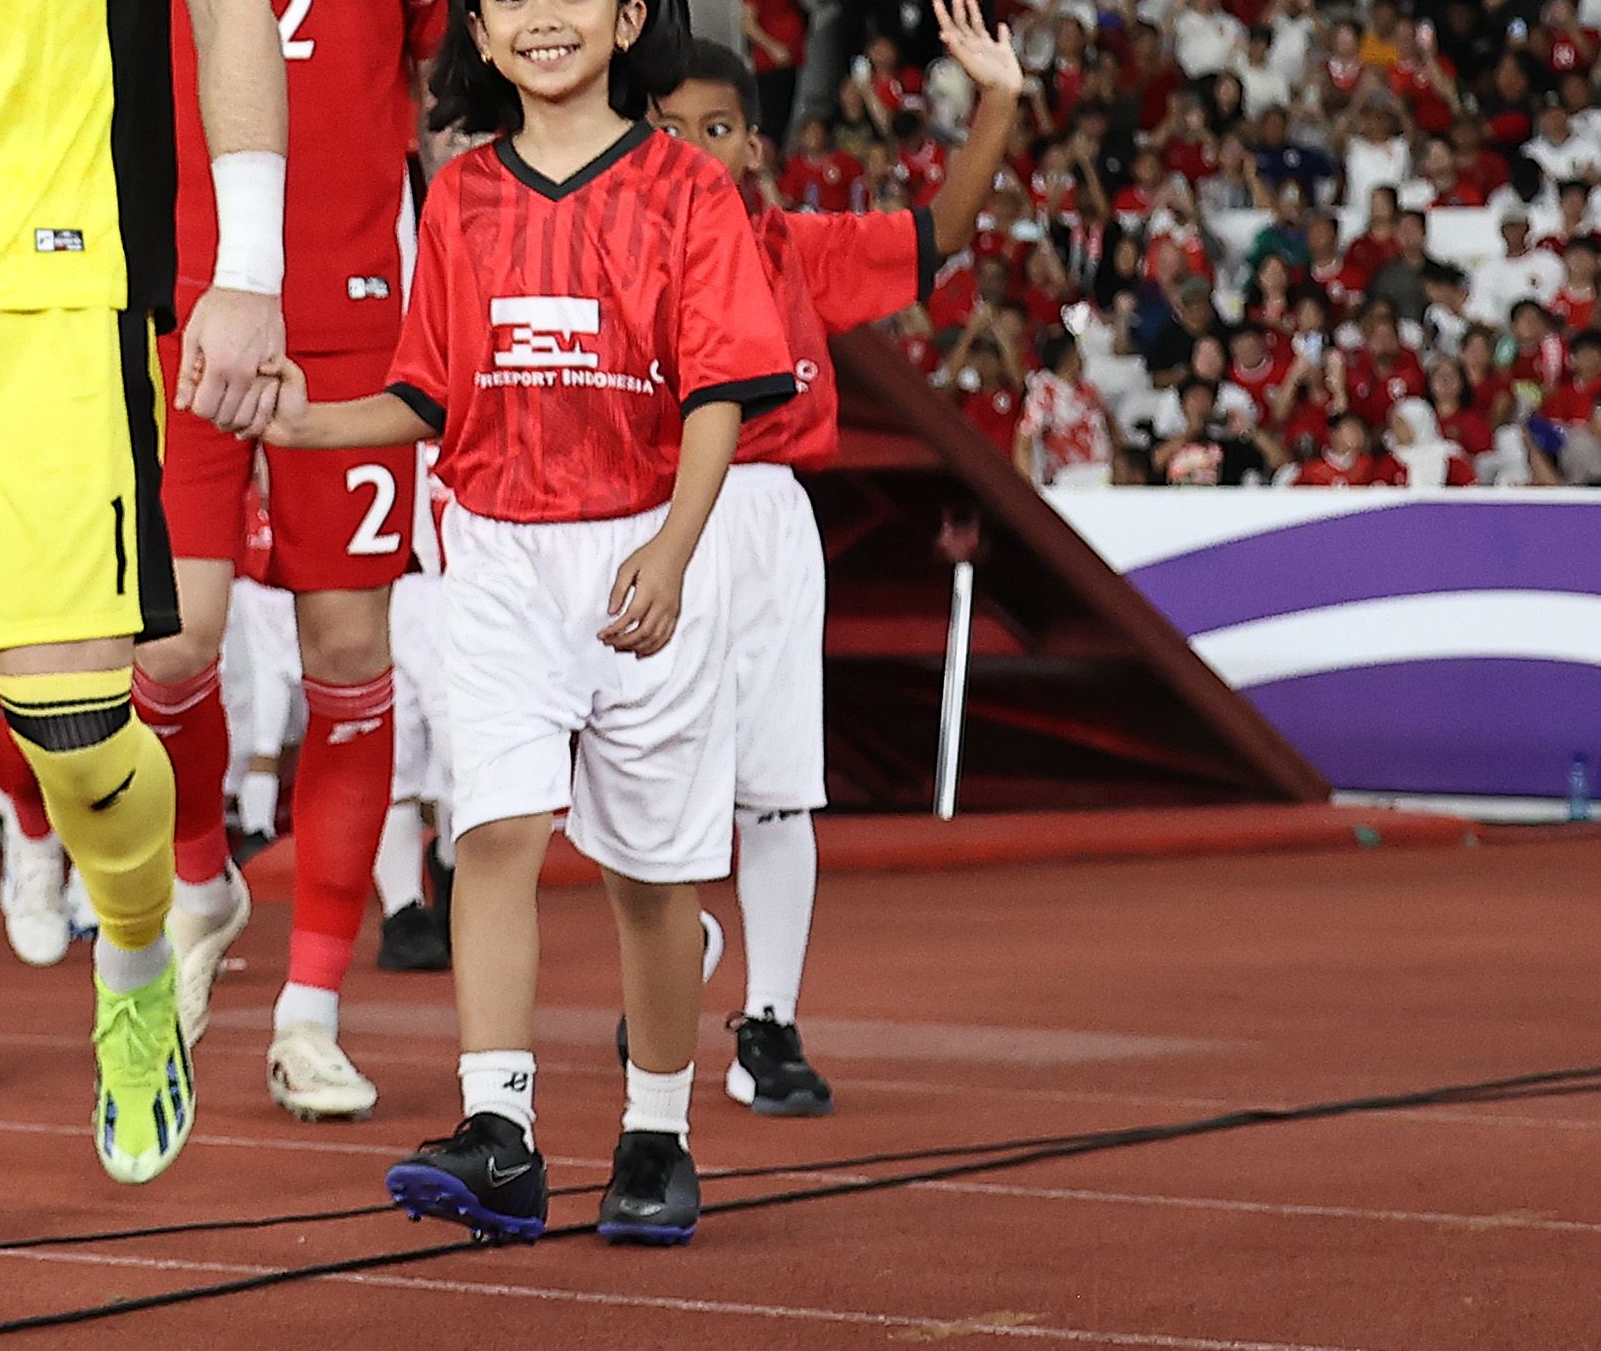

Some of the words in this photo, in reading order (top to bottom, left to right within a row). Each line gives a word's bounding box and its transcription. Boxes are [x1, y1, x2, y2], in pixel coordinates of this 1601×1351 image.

[562, 367, 655, 396] INDONESIA
[110, 495, 127, 596] 1
[347, 464, 401, 555] 2
